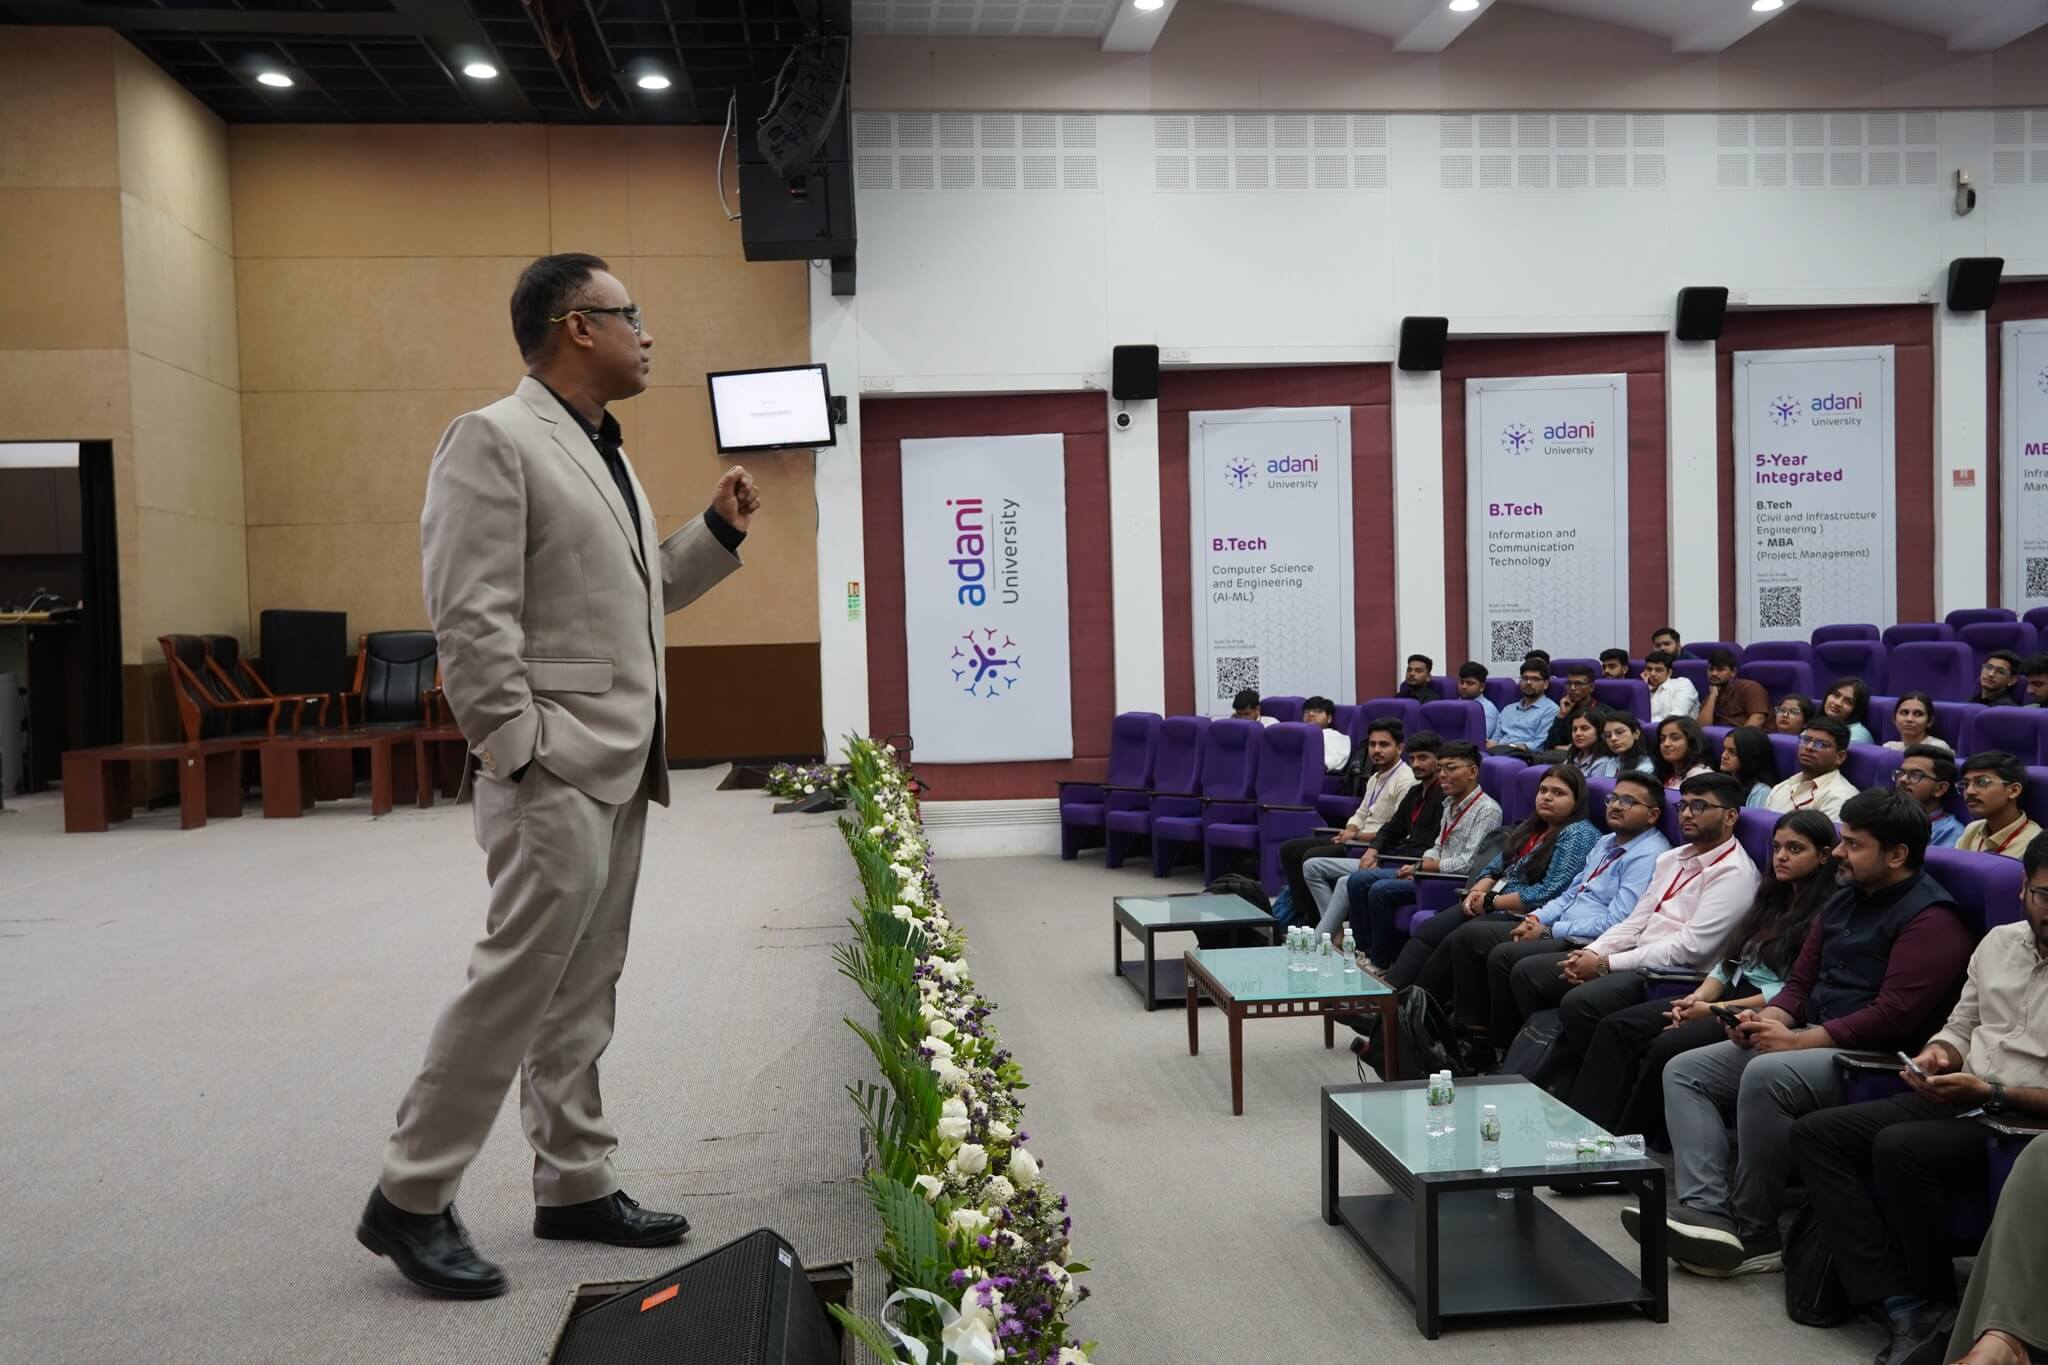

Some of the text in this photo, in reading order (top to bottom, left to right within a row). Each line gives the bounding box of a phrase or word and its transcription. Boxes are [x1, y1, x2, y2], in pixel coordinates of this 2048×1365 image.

[1811, 391, 1862, 411] adani
[1811, 416, 1863, 427] University
[1543, 420, 1595, 440] adani
[1544, 446, 1595, 456] University
[1267, 454, 1318, 473] adani
[1756, 453, 1808, 467] 5-Year
[1756, 468, 1843, 486] Integrated
[1267, 480, 1319, 490] University
[1489, 502, 1543, 517] B.Tech
[1756, 500, 1793, 511] B.Tech
[1756, 511, 1877, 524] (Civil and Infrastructure
[1488, 528, 1576, 540] Information and
[1756, 524, 1817, 536] Engineering
[1212, 537, 1267, 551] B.Tech
[1488, 542, 1575, 553] Communication
[1767, 538, 1794, 548] MBA
[946, 498, 986, 607] adani
[1000, 498, 1020, 604] University
[1756, 547, 1870, 562] (Project Management)
[1489, 556, 1551, 568] Technology
[1212, 563, 1314, 576] Computer Science
[1212, 577, 1303, 590] and Engineering
[1212, 591, 1255, 604] (AI-ML)
